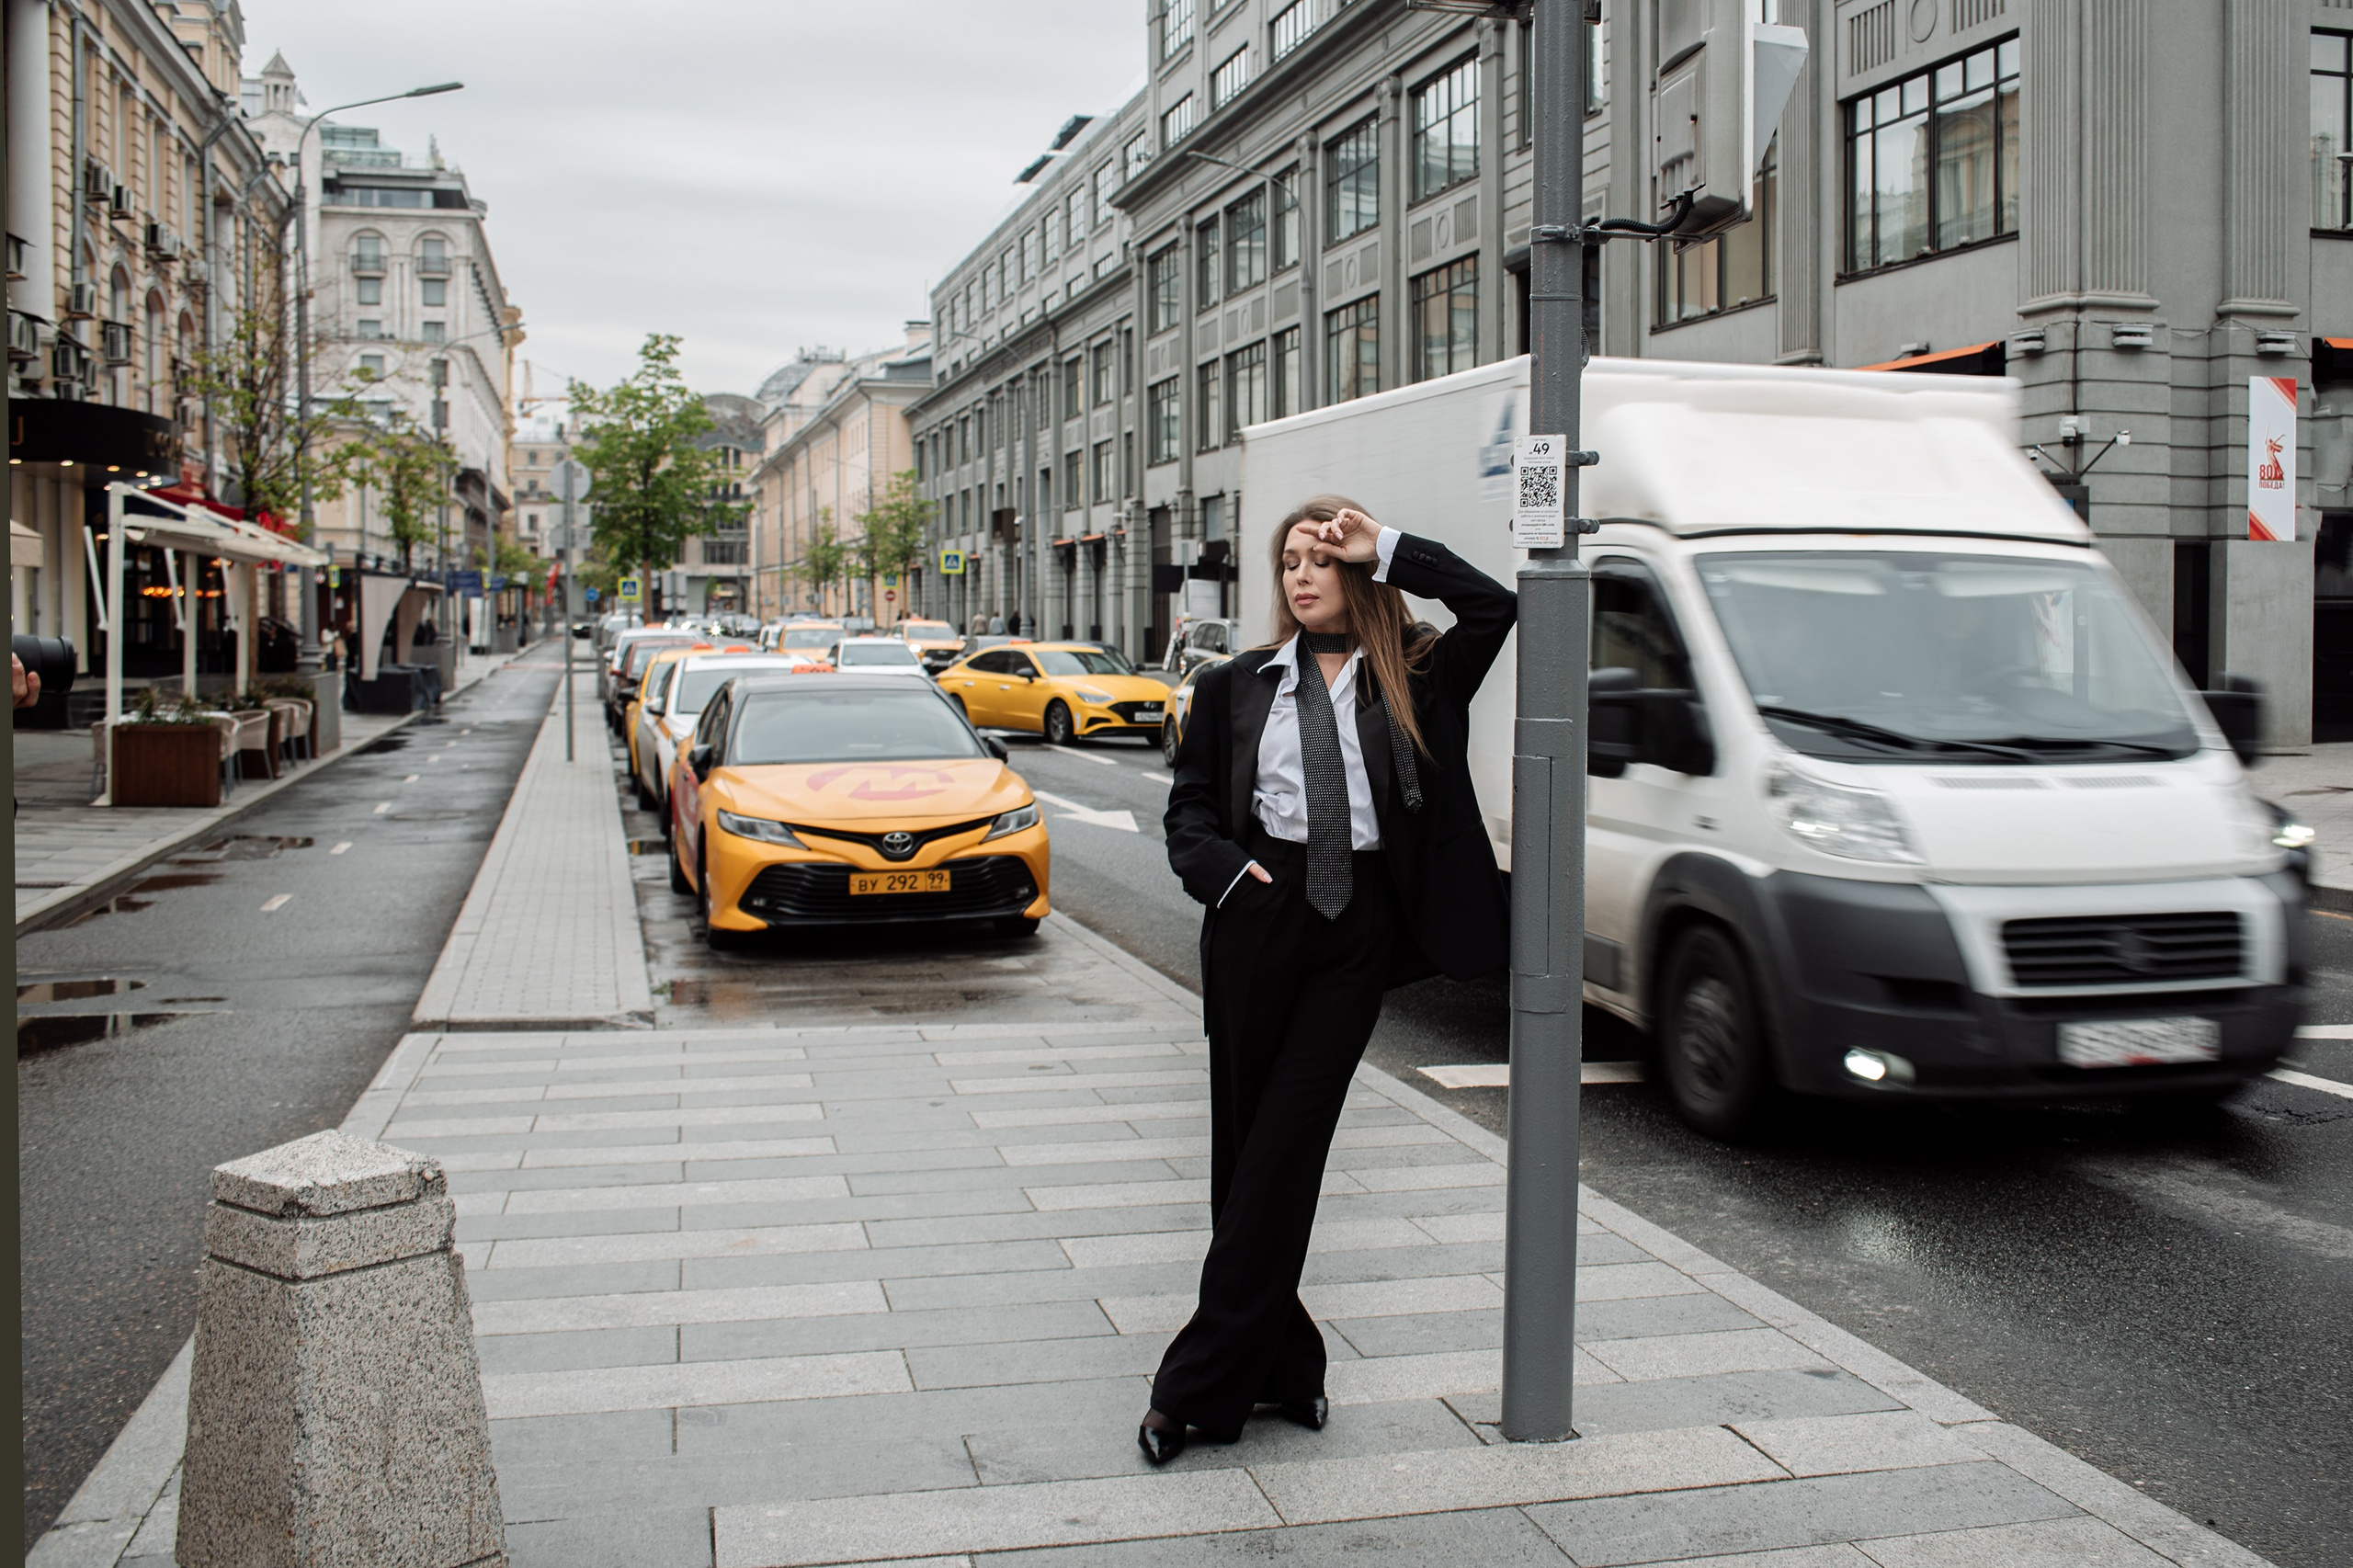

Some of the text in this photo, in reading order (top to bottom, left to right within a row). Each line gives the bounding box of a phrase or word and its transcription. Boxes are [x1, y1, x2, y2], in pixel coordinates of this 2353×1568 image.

[1532, 442, 1550, 455] 49
[2259, 464, 2273, 480] 80
[2258, 481, 2285, 490] ПОБЕДА!
[887, 874, 918, 891] 292
[927, 872, 944, 884] 99
